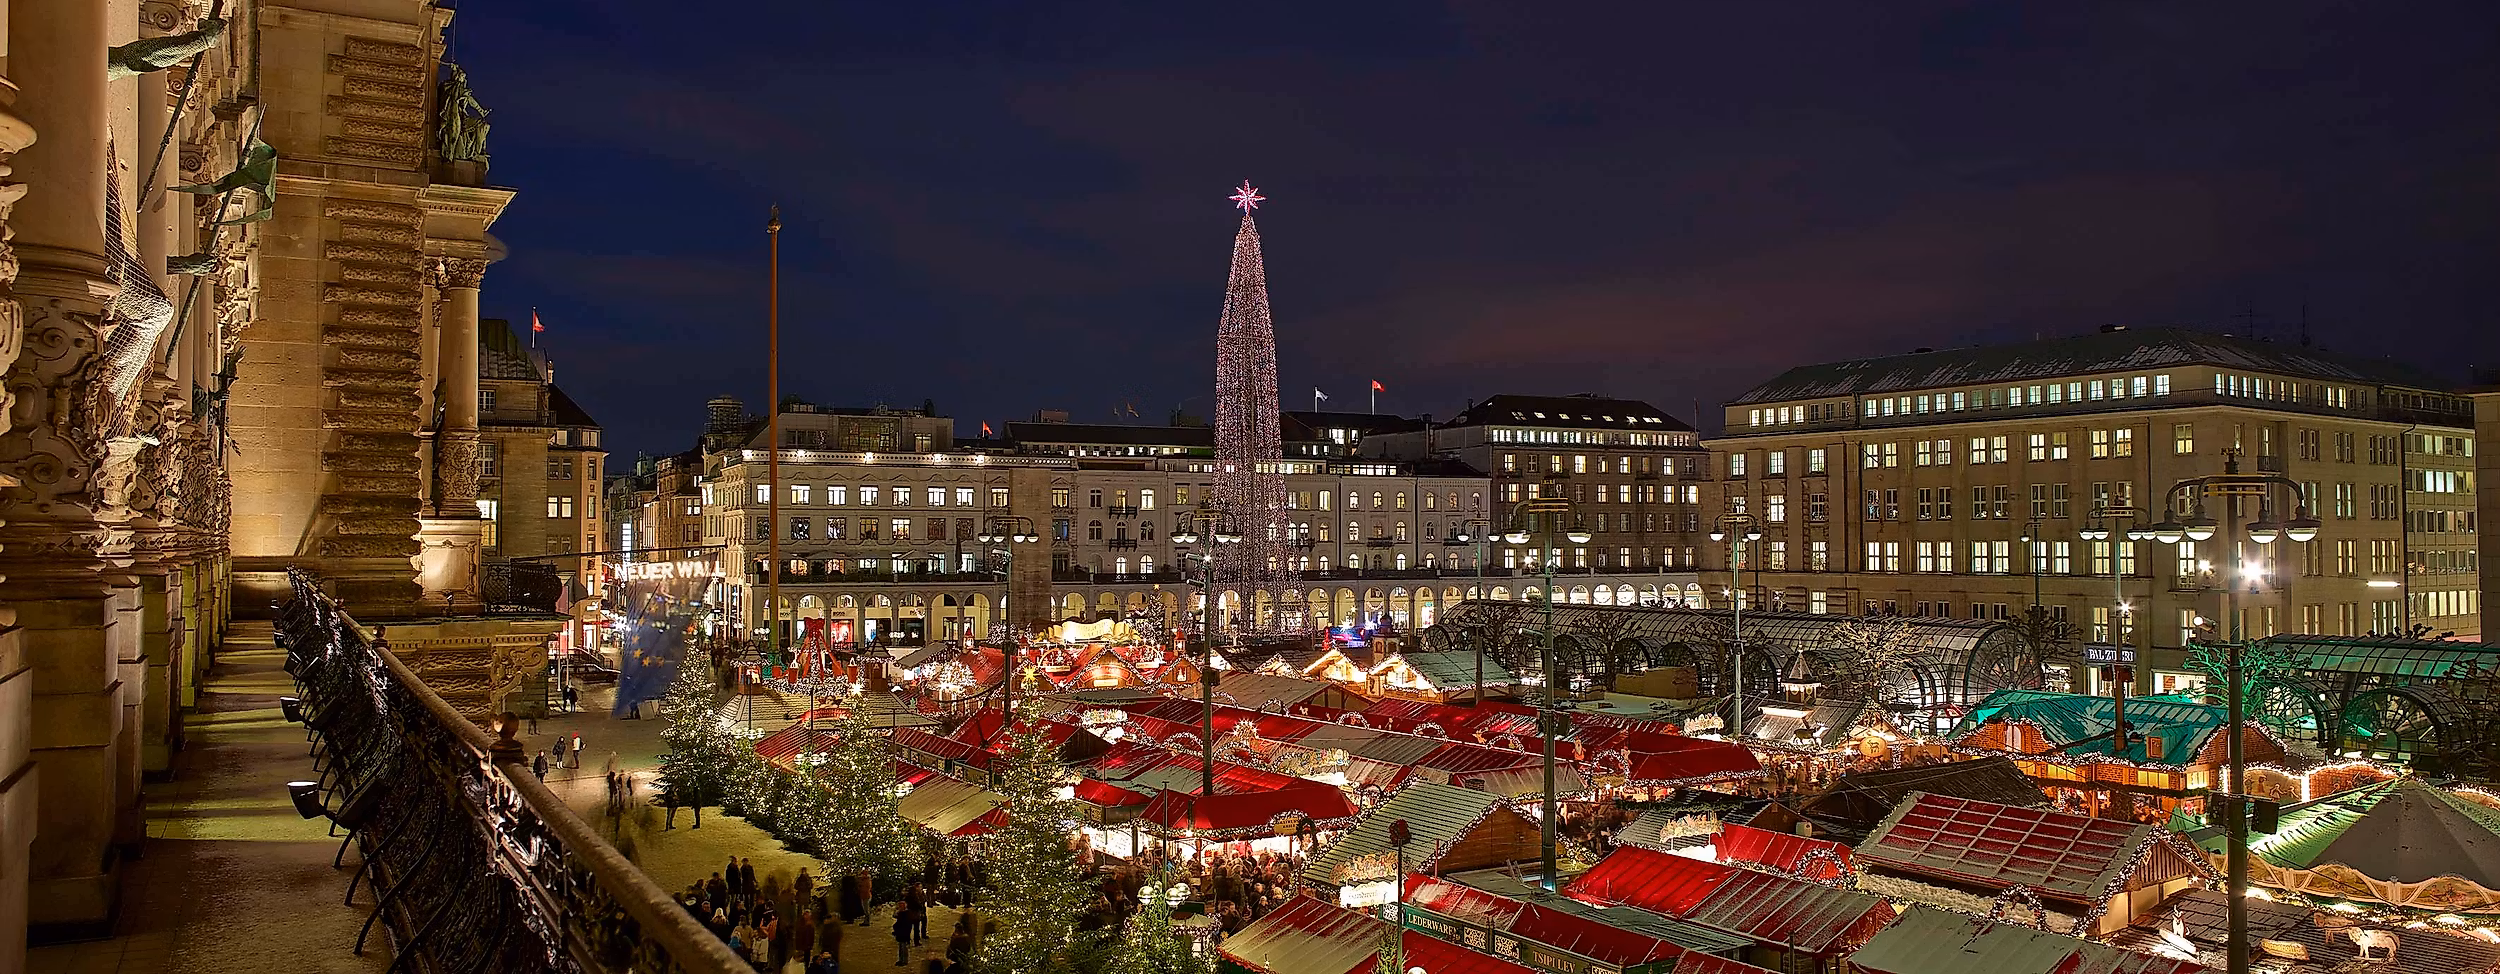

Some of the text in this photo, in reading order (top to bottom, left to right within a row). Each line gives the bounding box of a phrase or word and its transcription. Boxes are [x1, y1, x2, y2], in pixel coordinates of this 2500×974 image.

[614, 560, 726, 581] NEUER WALL
[1408, 913, 1459, 937] LEDERWAREN
